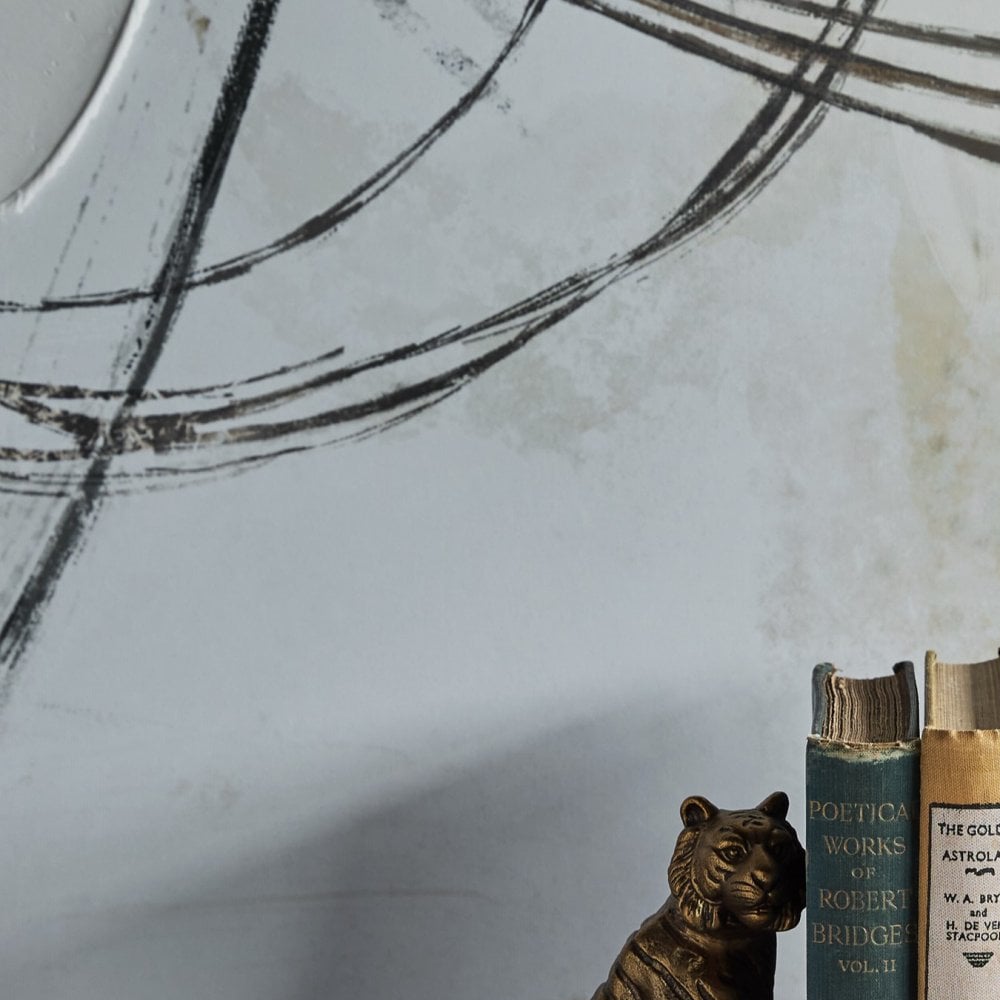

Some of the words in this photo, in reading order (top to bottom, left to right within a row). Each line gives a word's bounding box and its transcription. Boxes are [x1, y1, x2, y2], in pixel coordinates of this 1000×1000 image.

[809, 801, 917, 823] POETICA
[938, 821, 963, 836] THE
[823, 835, 906, 856] WORKS
[851, 867, 877, 880] OF
[819, 888, 914, 910] ROBERT
[944, 893, 959, 903] W.
[963, 894, 974, 904] A.
[970, 908, 987, 917] and
[946, 921, 957, 930] H.
[964, 921, 979, 931] DE
[812, 922, 918, 946] BRIDGES
[838, 959, 879, 973] VOL.
[883, 959, 896, 972] II
